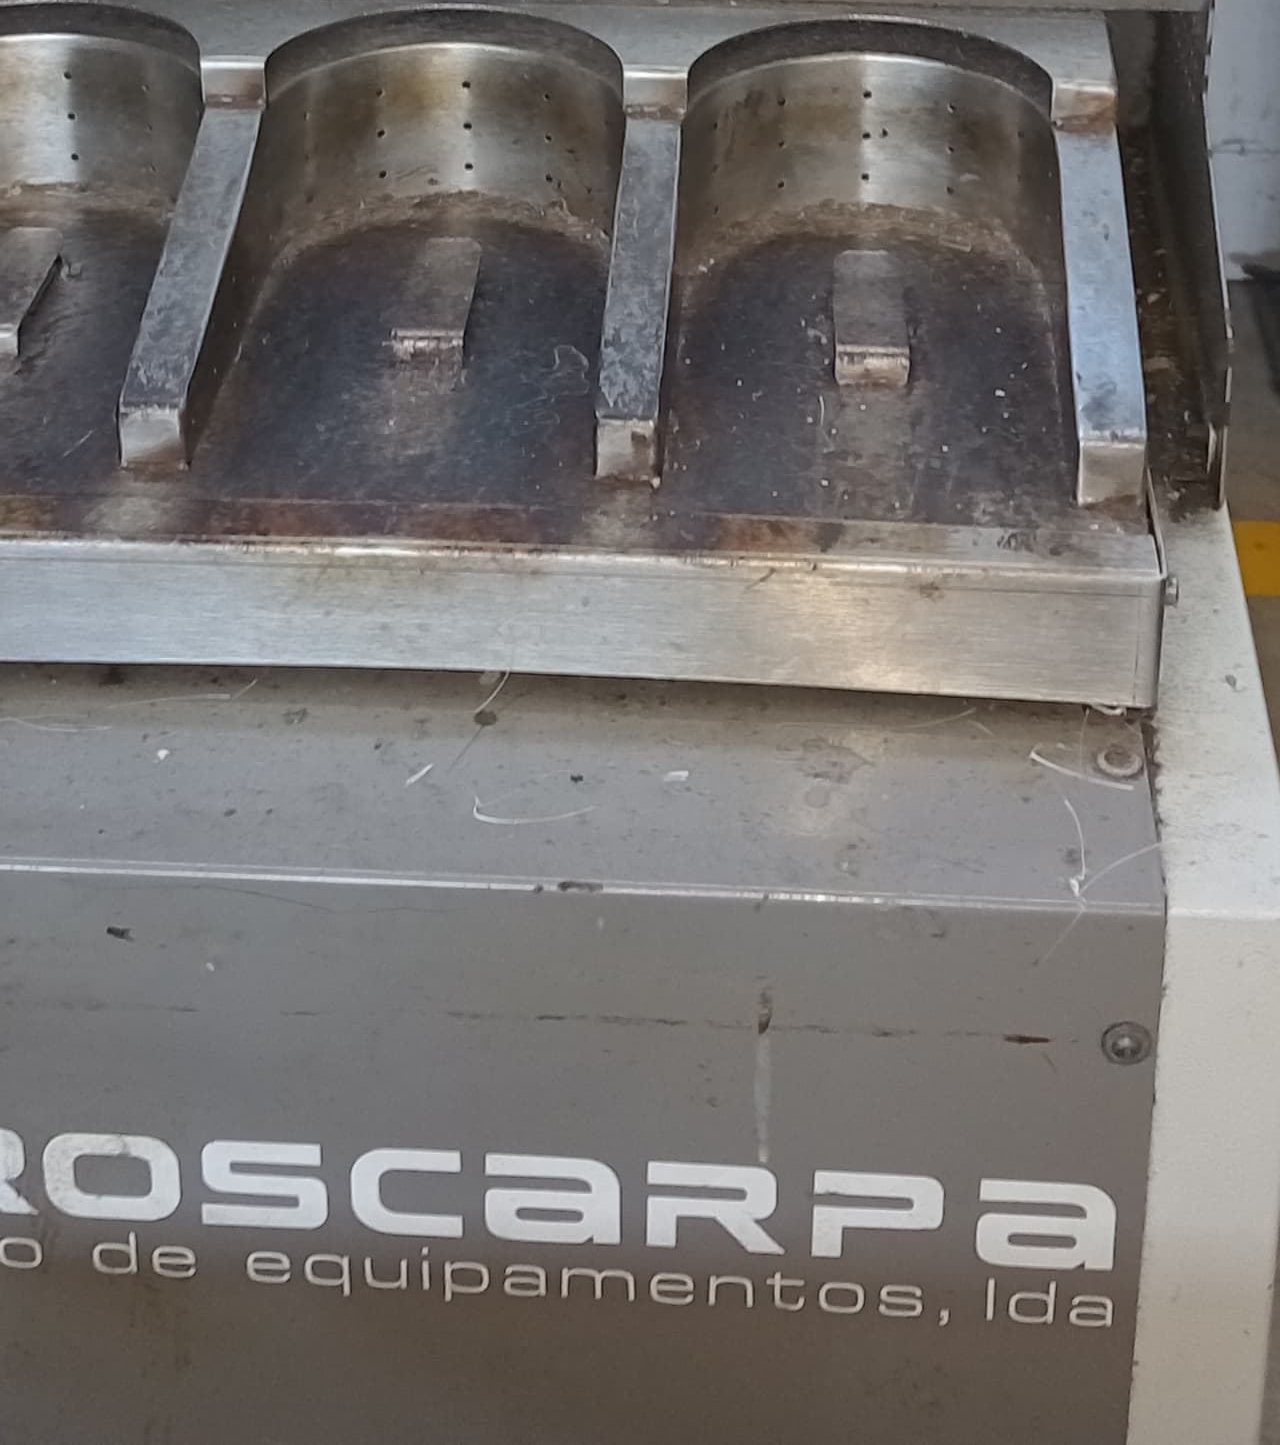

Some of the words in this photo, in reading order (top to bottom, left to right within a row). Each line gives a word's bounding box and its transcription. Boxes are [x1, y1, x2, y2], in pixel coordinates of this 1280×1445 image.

[92, 1232, 198, 1279] de
[246, 1246, 951, 1327] equipamentos,
[985, 1277, 1116, 1328] lda
